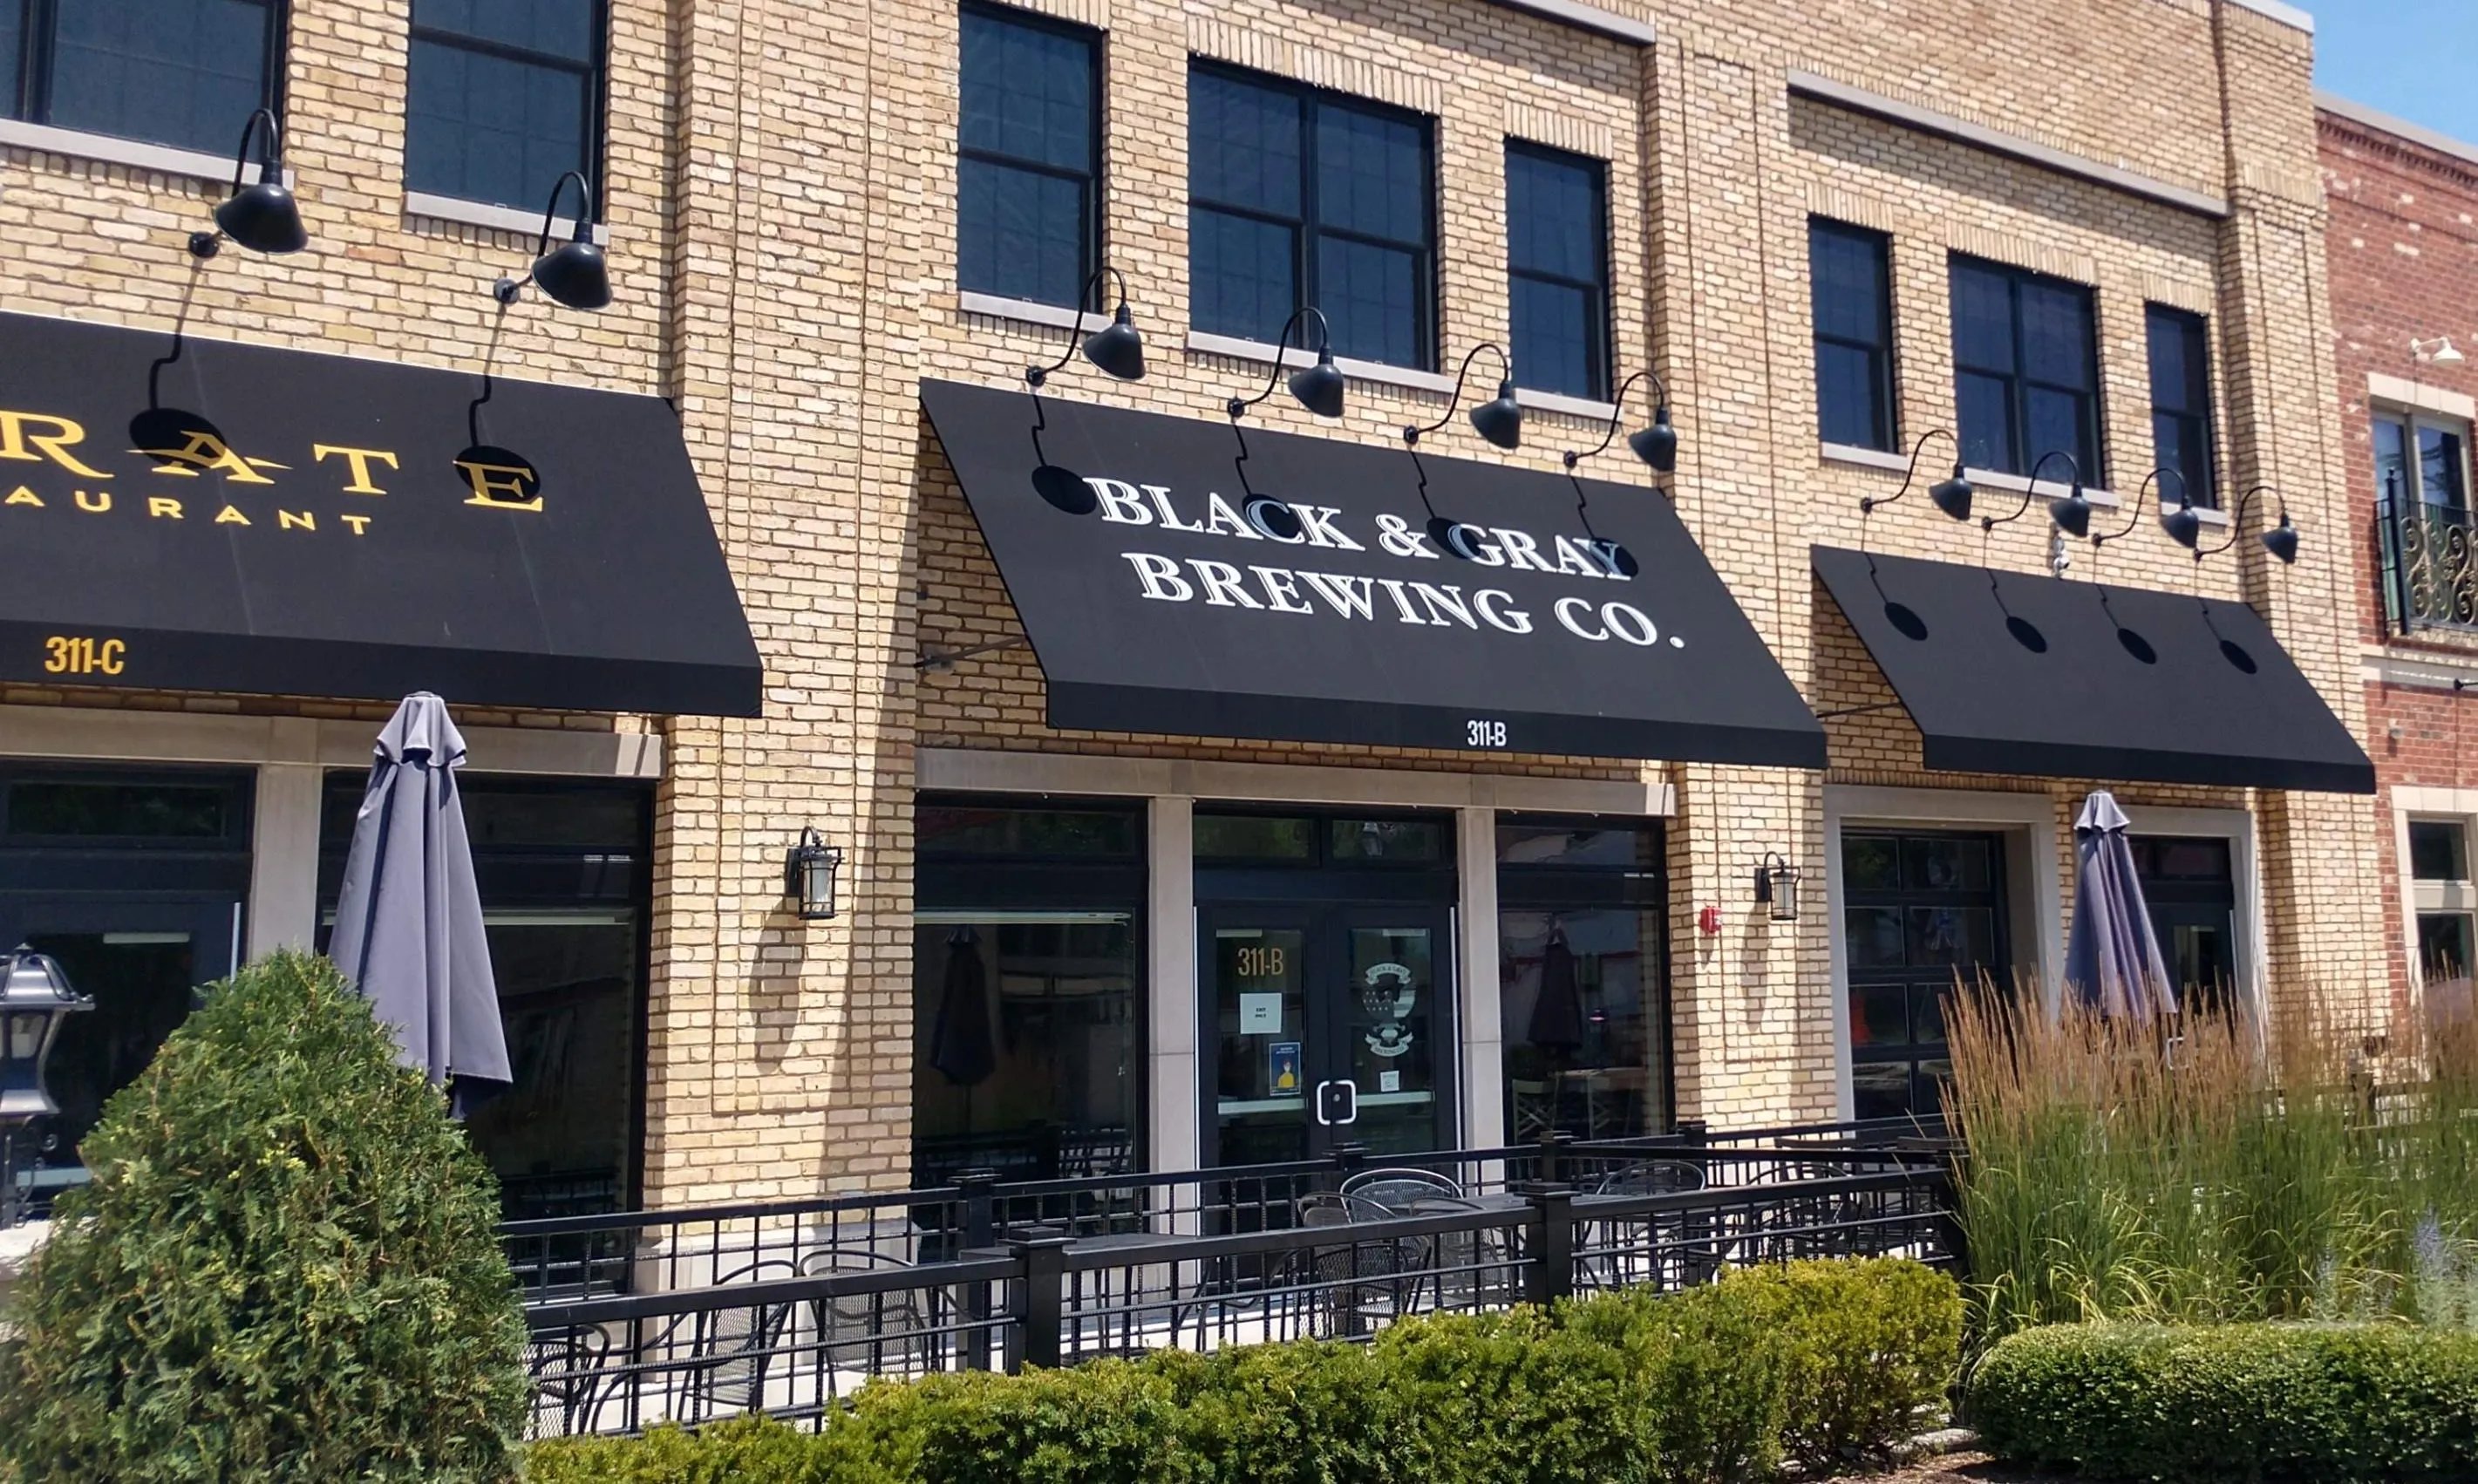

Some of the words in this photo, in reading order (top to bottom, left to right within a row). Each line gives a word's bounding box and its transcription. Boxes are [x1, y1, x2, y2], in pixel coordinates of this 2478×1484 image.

[5, 486, 371, 534] AURANT
[1082, 477, 1366, 552] BLACK
[1376, 513, 1440, 560] &
[1447, 523, 1632, 582] GRAY
[1121, 552, 1534, 635] BREWING
[1554, 597, 1686, 649] CO.
[44, 636, 126, 675] 311-C
[1467, 720, 1507, 747] 311-B
[1238, 948, 1283, 976] 311-B
